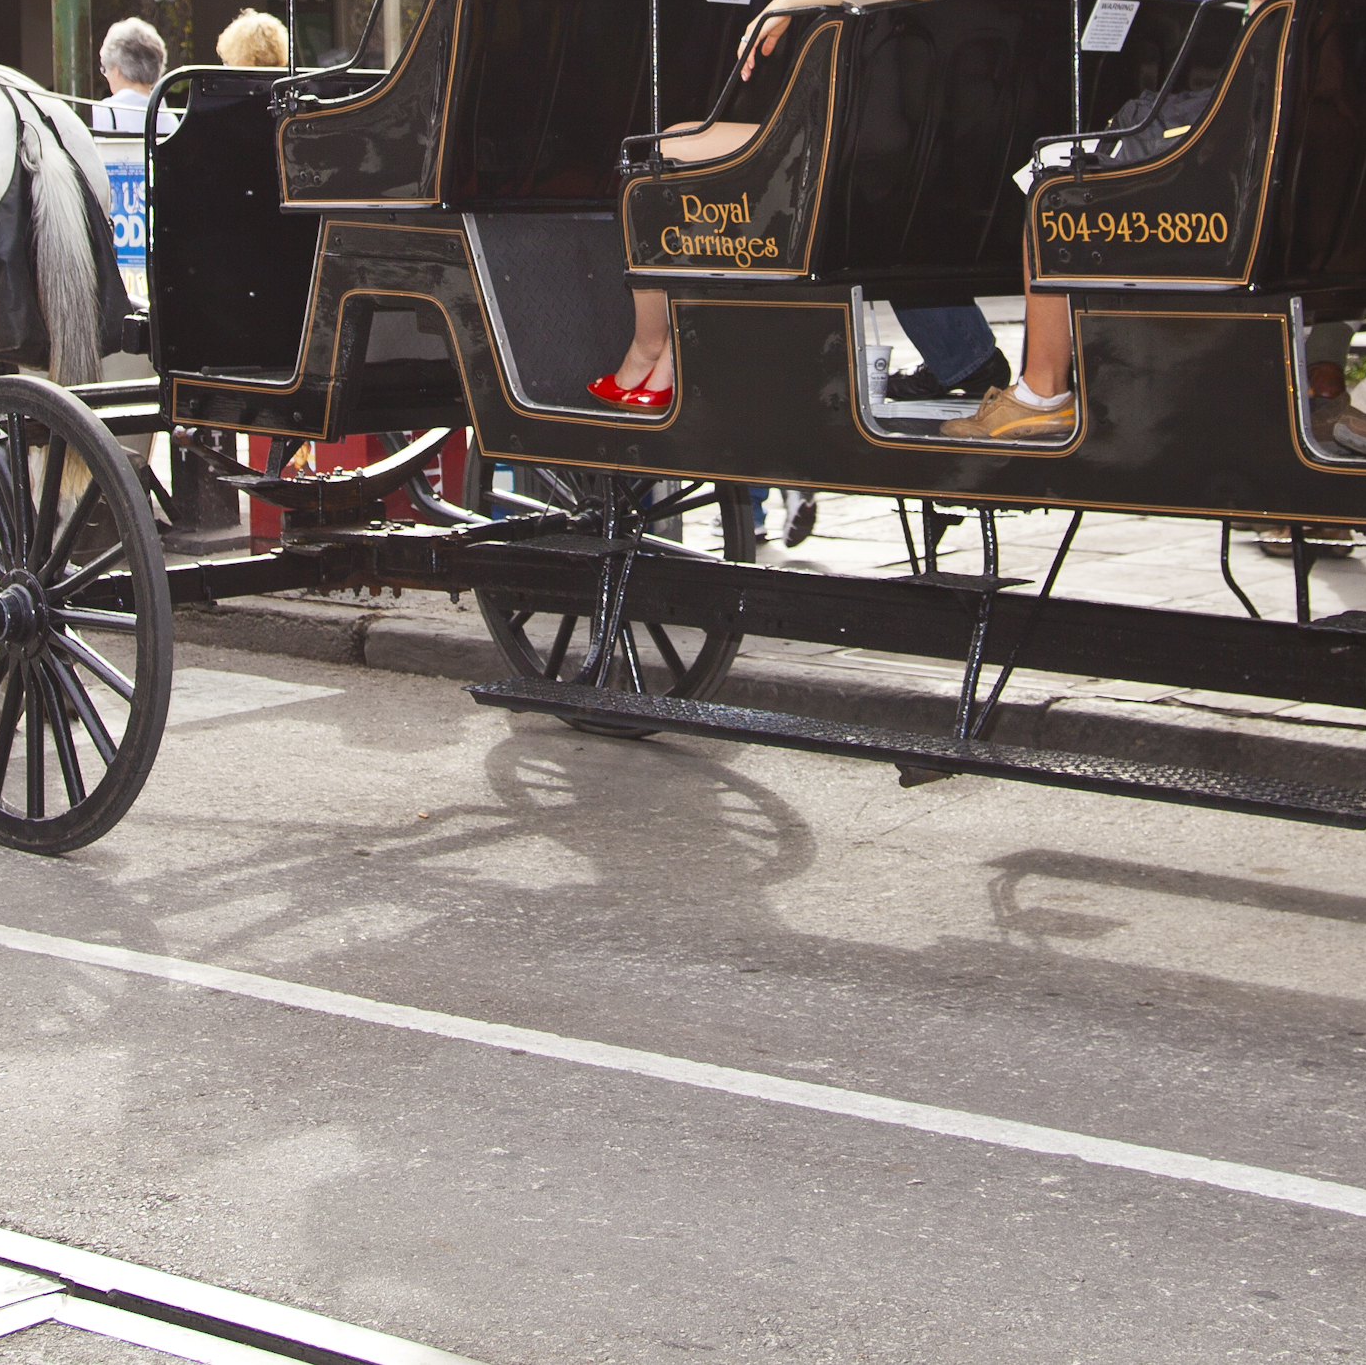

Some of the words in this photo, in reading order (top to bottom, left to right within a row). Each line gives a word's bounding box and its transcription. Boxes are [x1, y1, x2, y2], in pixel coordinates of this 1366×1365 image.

[1101, 2, 1134, 12] WARNING
[680, 191, 752, 234] Royal
[1041, 210, 1229, 243] 504-943-8820
[661, 226, 779, 268] Carriages
